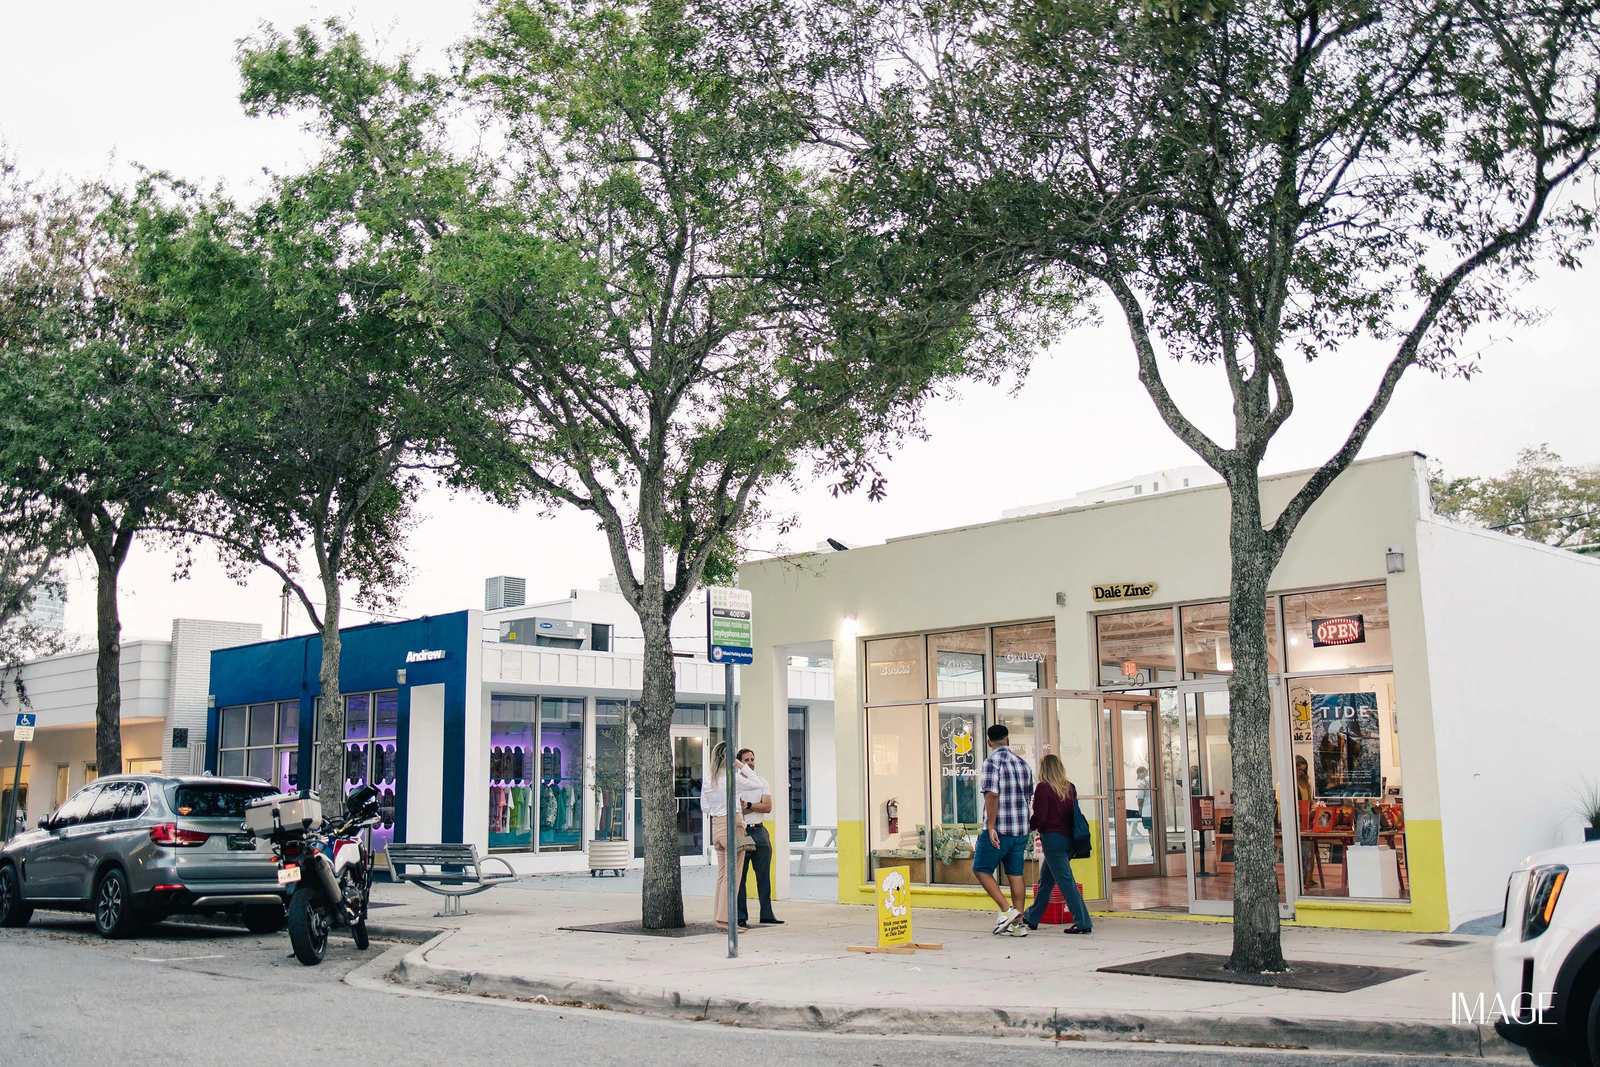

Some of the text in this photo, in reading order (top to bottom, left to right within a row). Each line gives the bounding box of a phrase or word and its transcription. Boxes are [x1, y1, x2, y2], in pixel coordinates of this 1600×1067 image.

[1094, 585, 1121, 599] Dalé
[729, 600, 750, 608] phone
[714, 630, 750, 638] paybyphone.com
[1317, 622, 1359, 640] OPEN
[406, 650, 444, 662] Andrew
[1005, 651, 1047, 664] Gallery
[944, 660, 972, 669] Zines
[880, 665, 910, 676] Books
[1320, 706, 1370, 718] TIDE
[942, 766, 960, 776] Dalé
